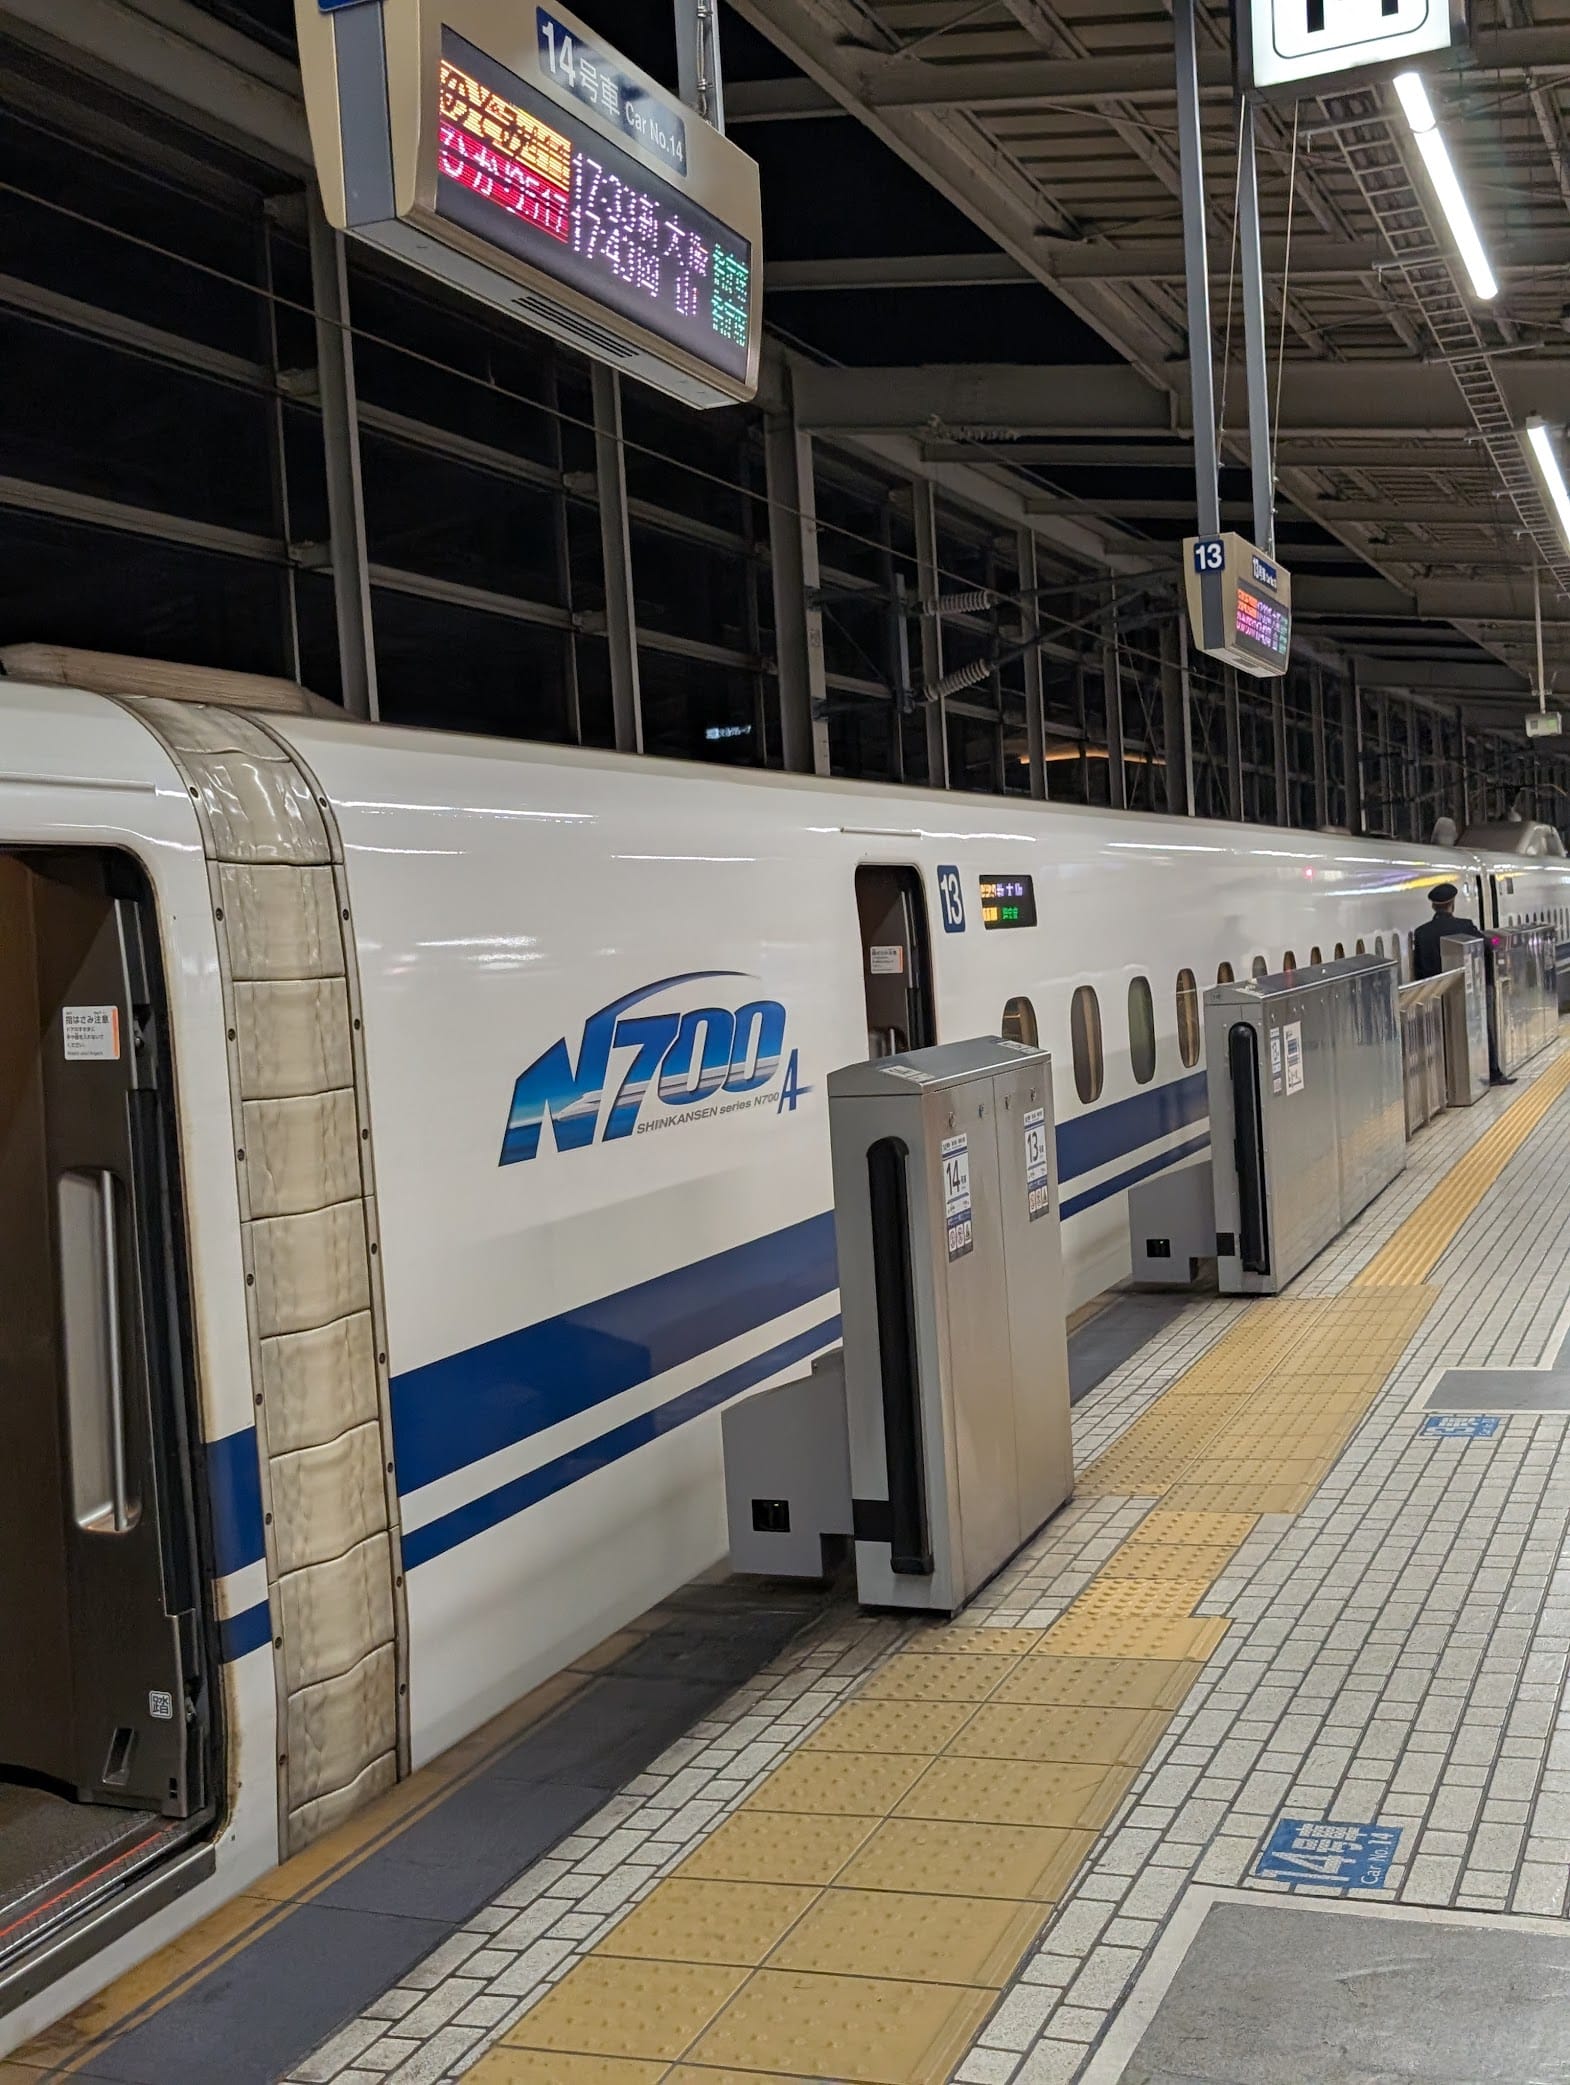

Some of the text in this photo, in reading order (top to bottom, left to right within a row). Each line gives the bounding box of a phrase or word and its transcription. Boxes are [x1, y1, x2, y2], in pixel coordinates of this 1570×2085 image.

[542, 21, 620, 116] 14号車
[625, 101, 647, 134] Car
[1195, 543, 1222, 570] 13
[940, 873, 963, 925] 13
[498, 1000, 786, 1167] N700
[637, 1092, 779, 1134] SHINKANSEN series N700
[152, 1695, 170, 1715] 踏
[1259, 1823, 1368, 1882] 14号車
[1361, 1865, 1381, 1885] Car
